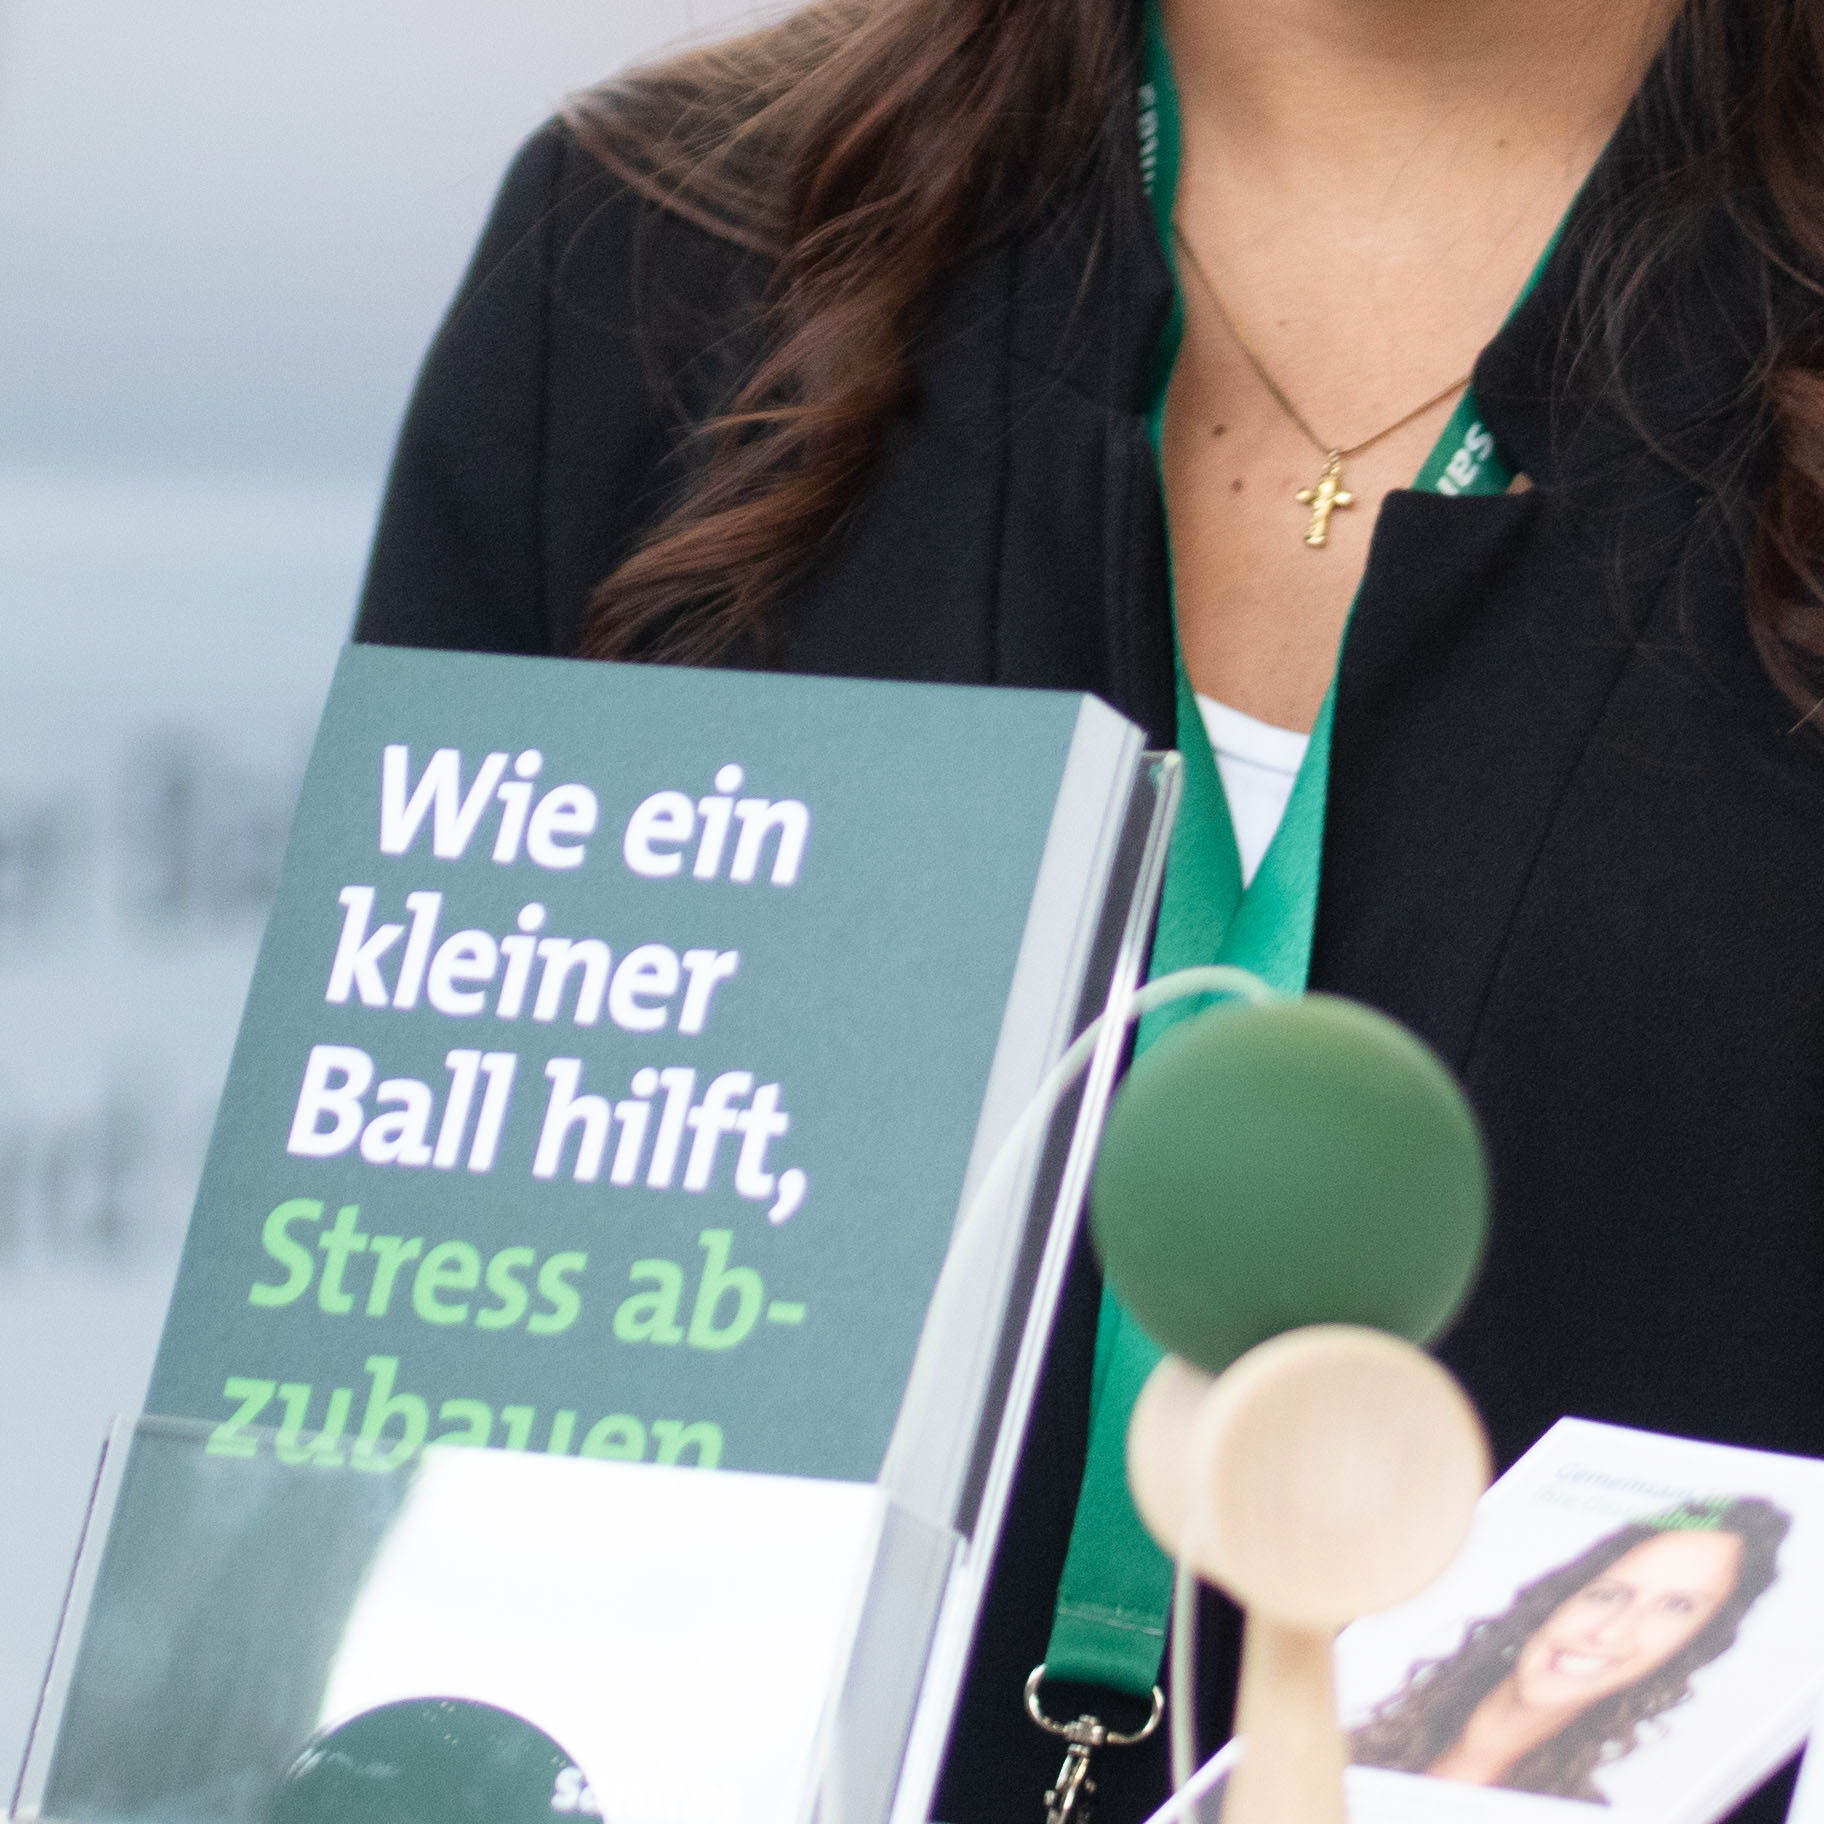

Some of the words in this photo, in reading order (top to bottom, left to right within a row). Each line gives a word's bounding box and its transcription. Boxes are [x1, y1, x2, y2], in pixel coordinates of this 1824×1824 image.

[379, 744, 598, 869] Wie
[622, 763, 811, 887] ein
[324, 884, 740, 1035] kleiner
[285, 1043, 514, 1173] Ball
[531, 1057, 807, 1224] hilft,
[247, 1196, 587, 1338] Stress
[612, 1229, 809, 1352] ab-
[205, 1355, 724, 1473] zubauen
